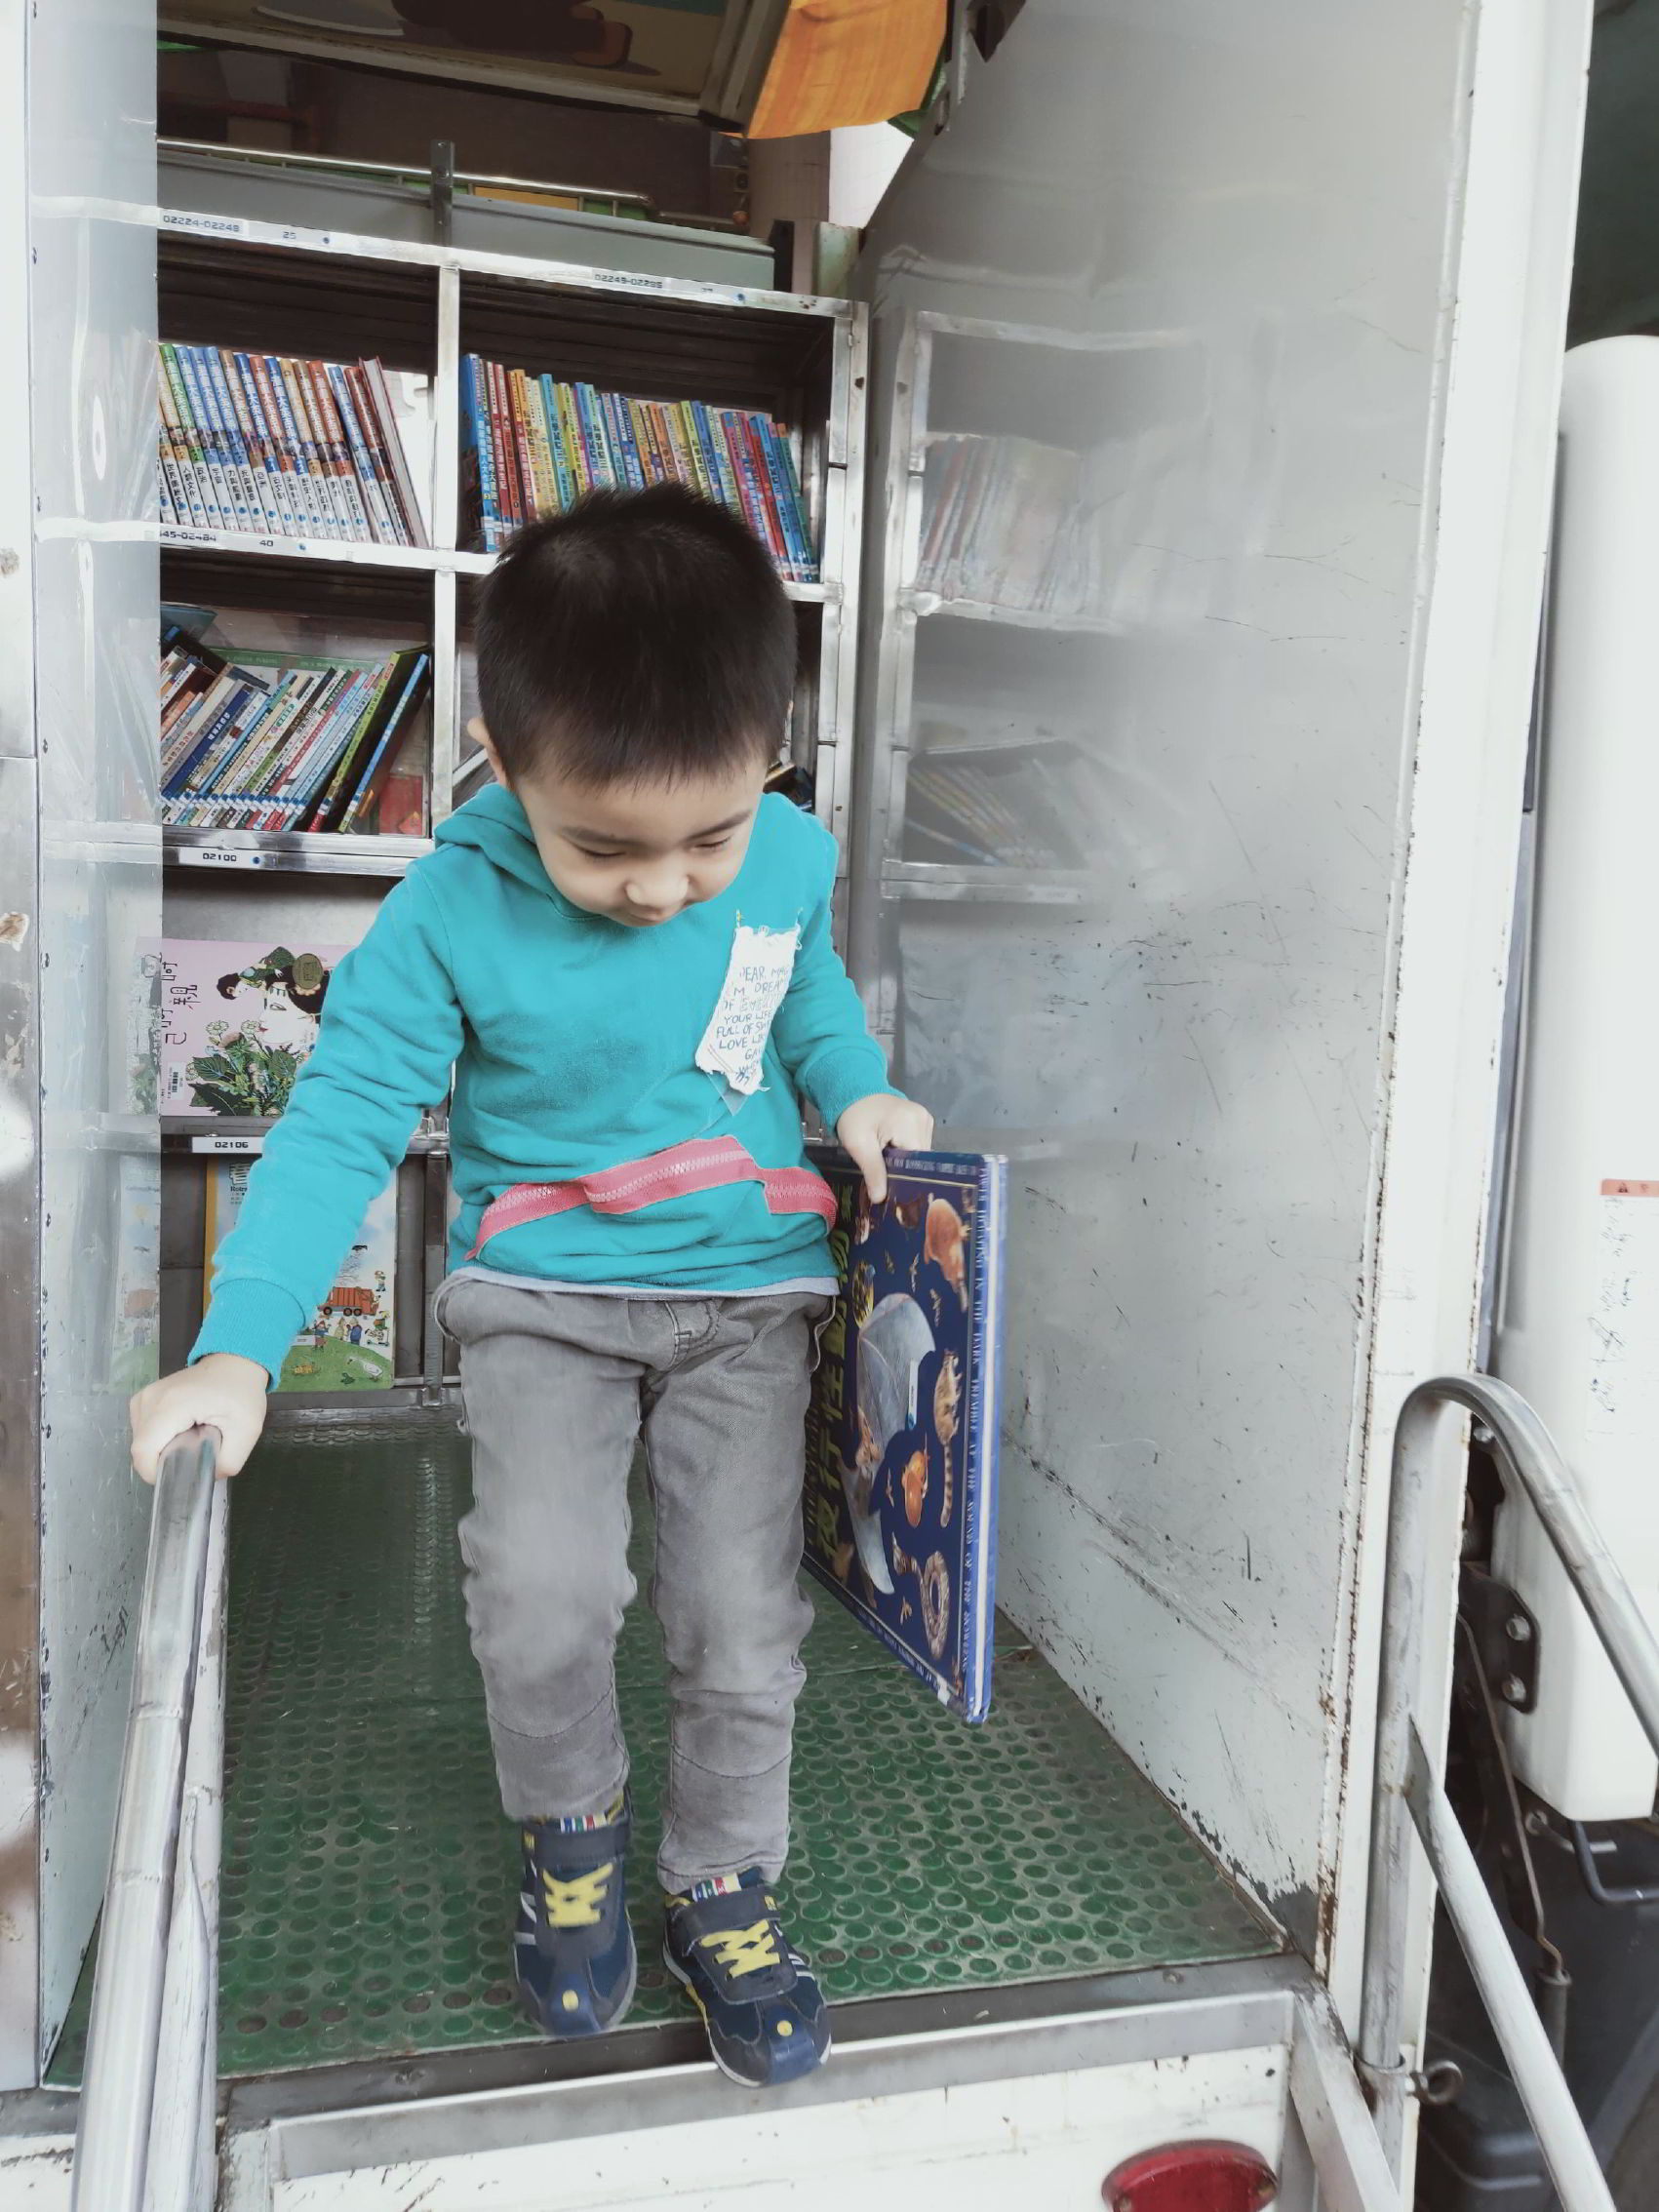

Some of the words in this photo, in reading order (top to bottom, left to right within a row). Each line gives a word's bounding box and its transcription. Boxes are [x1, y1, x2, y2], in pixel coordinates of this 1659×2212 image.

[202, 851, 238, 863] 02100
[724, 1012, 753, 1025] YOUR
[719, 1037, 749, 1050] LOVE
[214, 1140, 250, 1149] 02106
